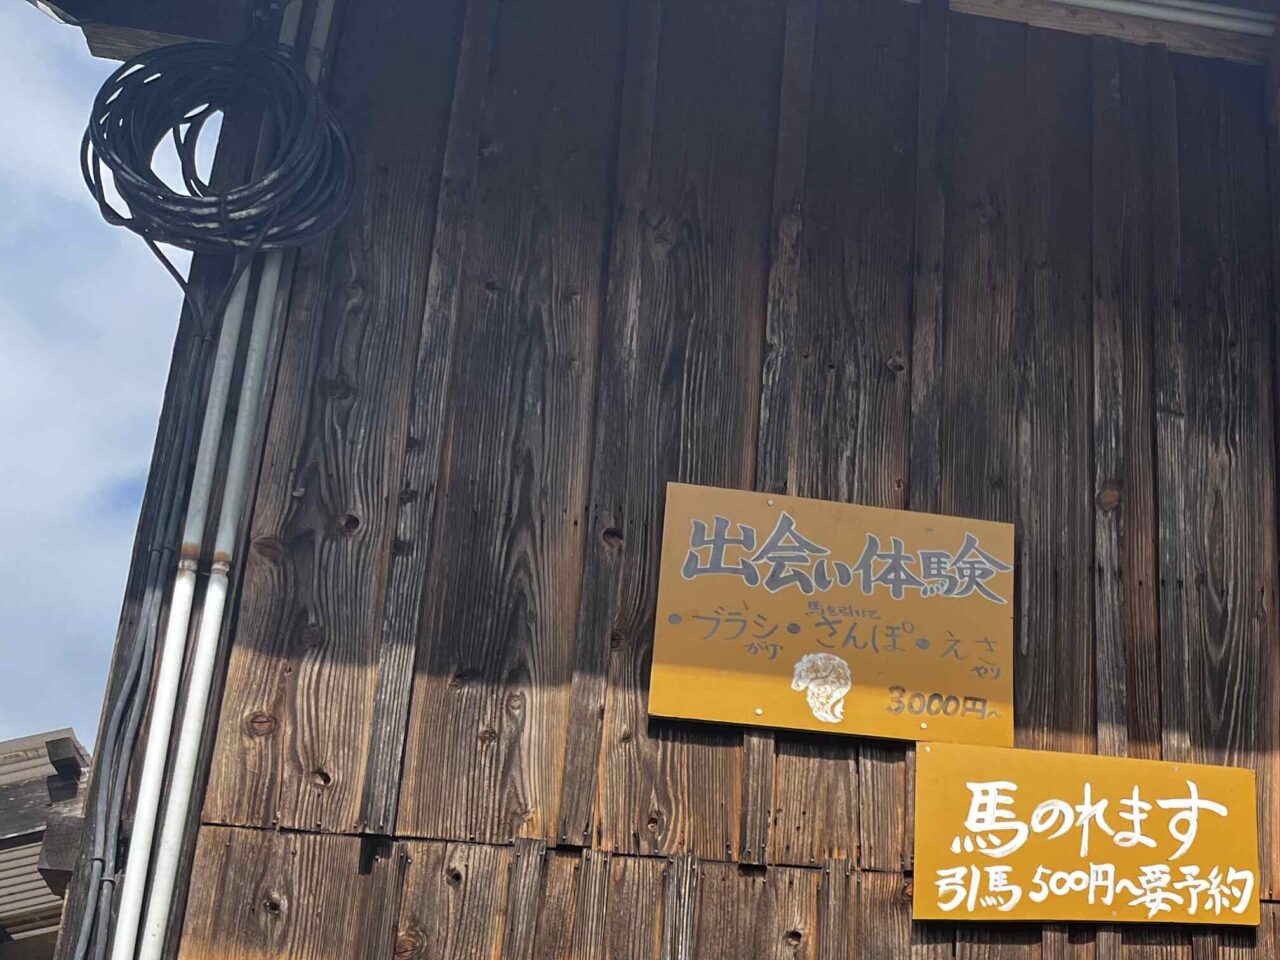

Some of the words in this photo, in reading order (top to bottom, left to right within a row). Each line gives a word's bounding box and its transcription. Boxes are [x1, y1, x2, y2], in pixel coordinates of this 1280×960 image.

[681, 511, 1013, 605] 出会い体験
[950, 780, 1228, 861] 馬のれます
